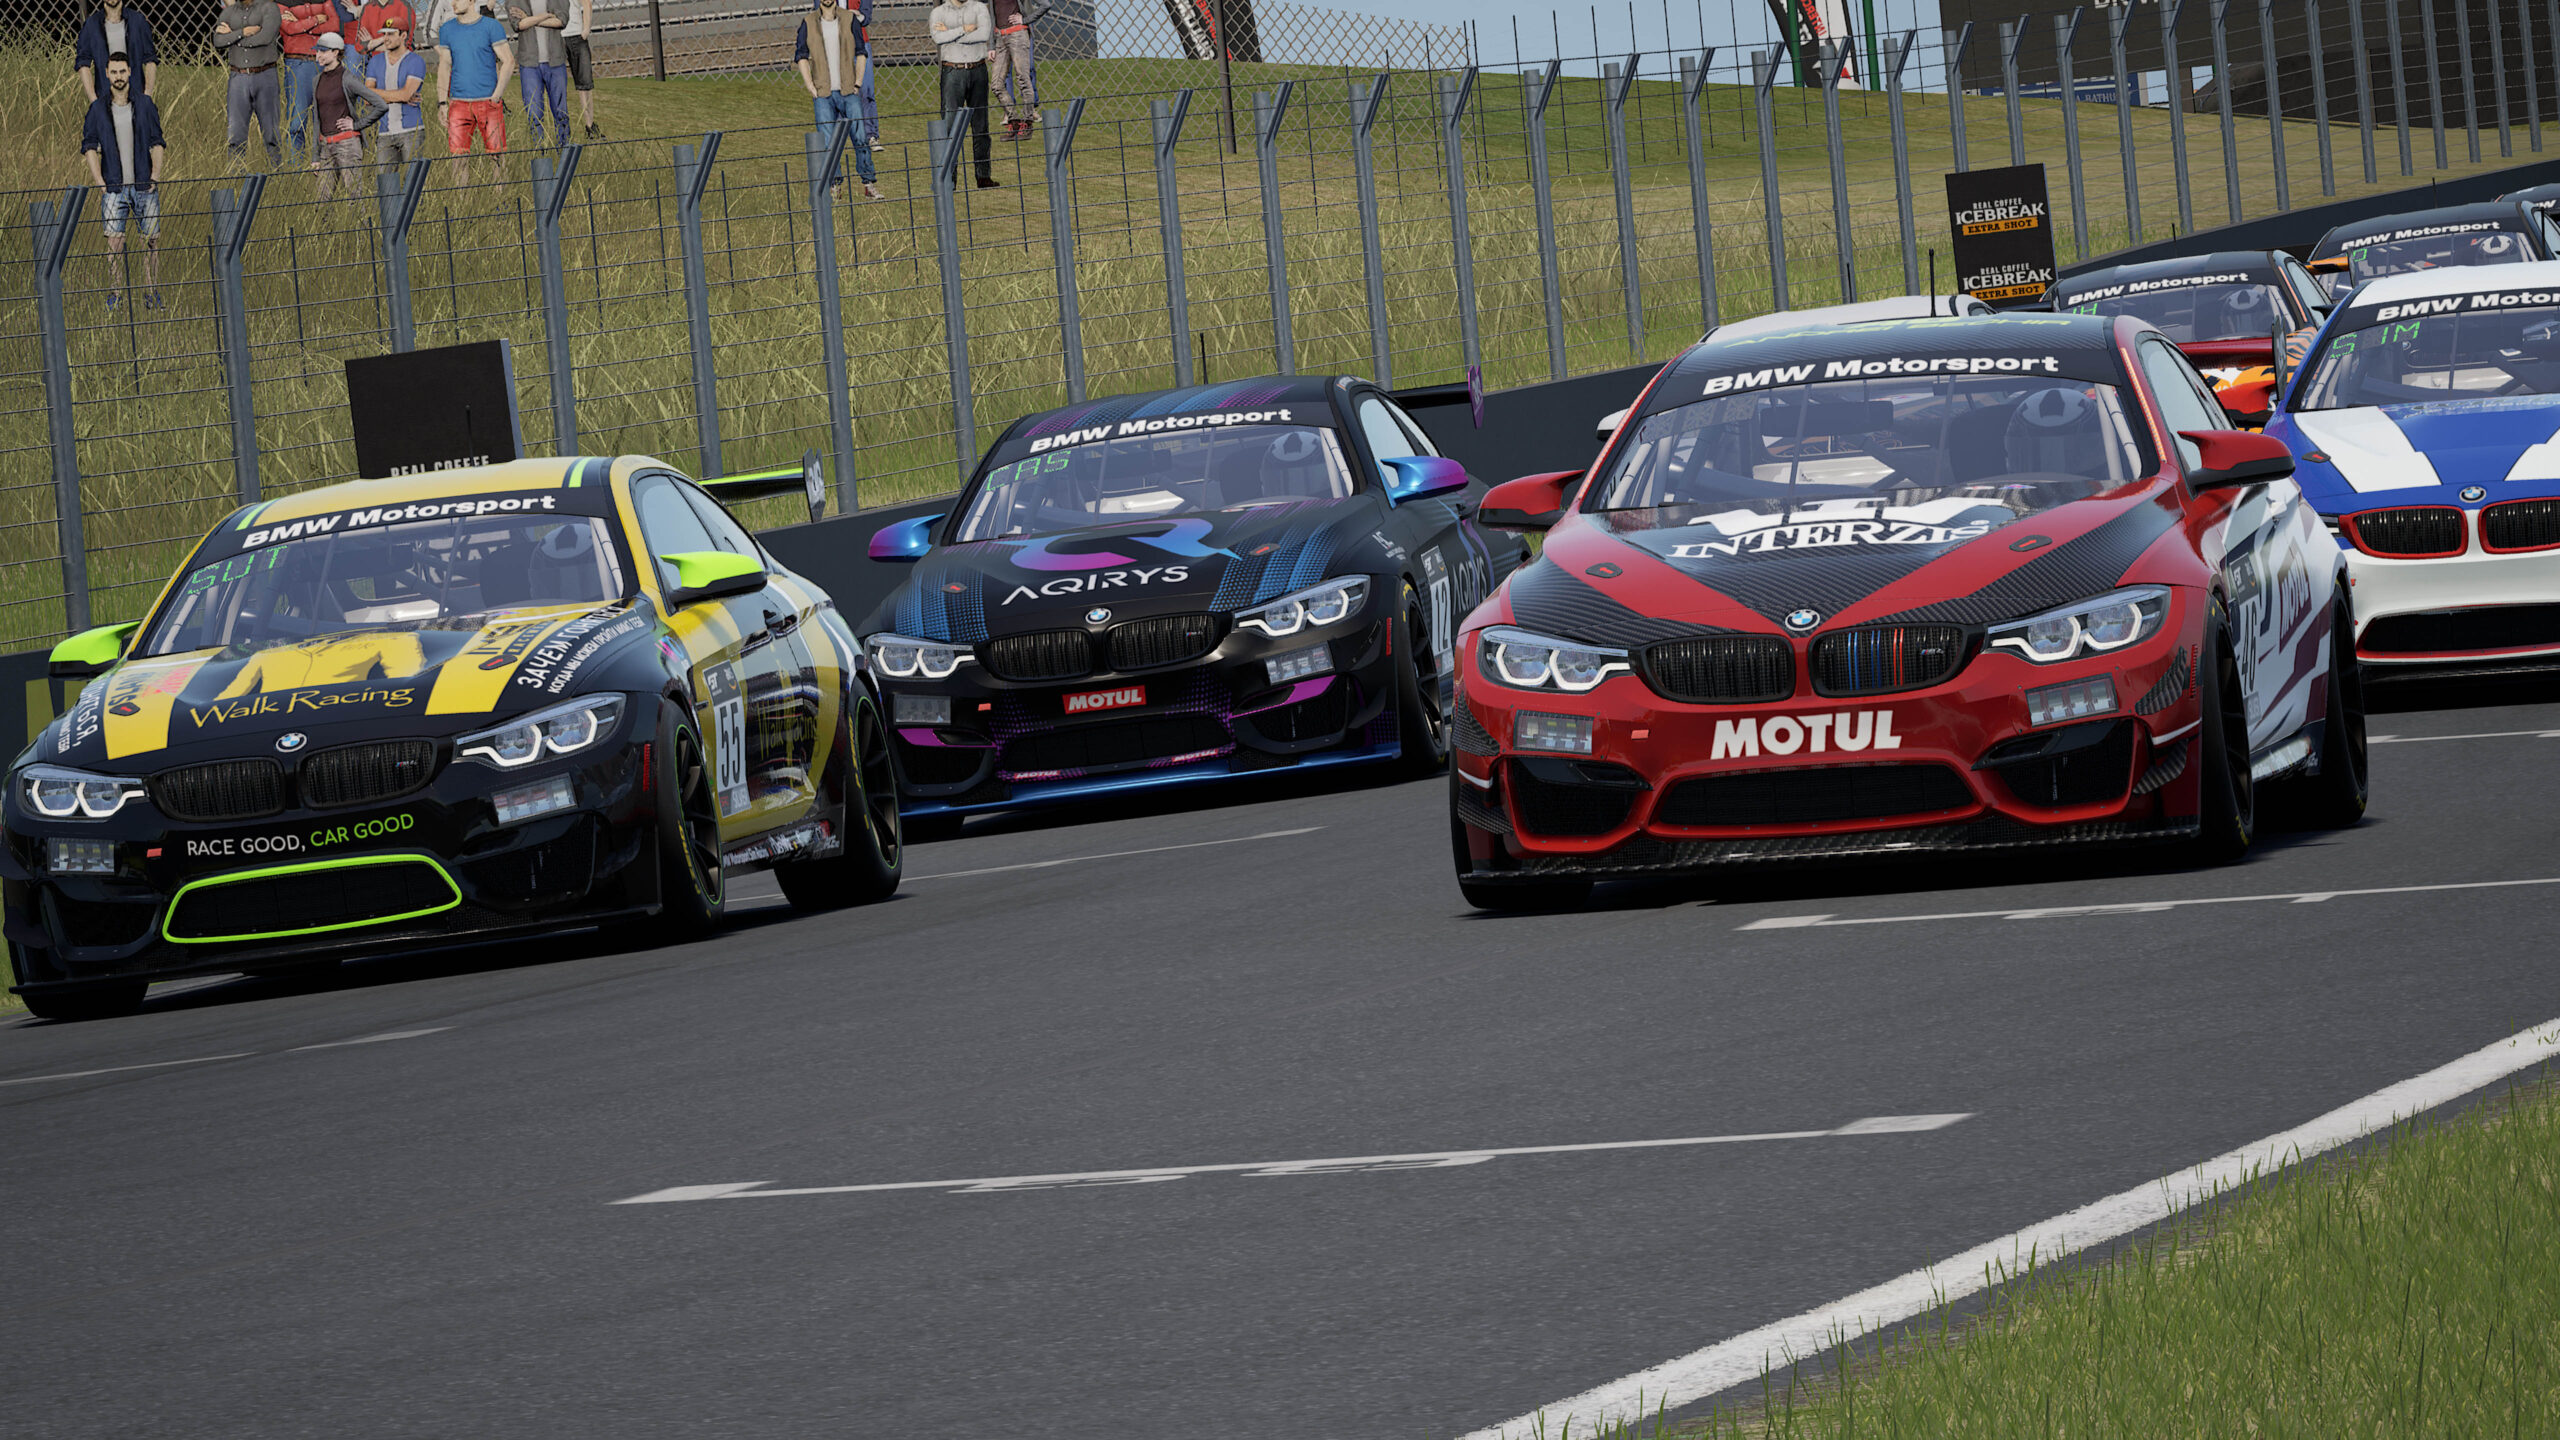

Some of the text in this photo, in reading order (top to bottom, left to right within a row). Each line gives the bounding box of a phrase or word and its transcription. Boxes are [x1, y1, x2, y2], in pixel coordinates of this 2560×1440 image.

[1955, 202, 2045, 225] ICEBREAK
[1973, 197, 2022, 210] REAL COFFEE
[1968, 220, 2032, 233] EXTRA SHOT
[2341, 221, 2500, 250] BMW Motorsport
[1963, 268, 2053, 290] ICEBREAK
[1980, 263, 2030, 275] REAL COFFEE
[1976, 286, 2040, 299] EXTRA SHOT
[2068, 272, 2249, 306] BMW Motorsport
[2376, 296, 2464, 321] BMW
[1702, 355, 2060, 396] BMW Motorsport
[1029, 409, 1292, 453] BMW Motorsport
[242, 495, 556, 548] BMW Motorsport
[1667, 519, 1990, 558] INTERZIS
[1001, 565, 1189, 607] AQIRYS
[1433, 580, 1449, 653] 12
[517, 640, 573, 688] ЗАЧЕМ
[2241, 600, 2258, 696] 46
[190, 687, 416, 728] Walk Racing
[1068, 688, 1143, 711] MOTUL
[719, 702, 741, 788] 55
[1710, 710, 1902, 760] MOTUL
[1173, 750, 1218, 762] MOTUL
[1015, 770, 1060, 779] MOTUL
[187, 813, 414, 856] RACE GOOD, CAR GOOD
